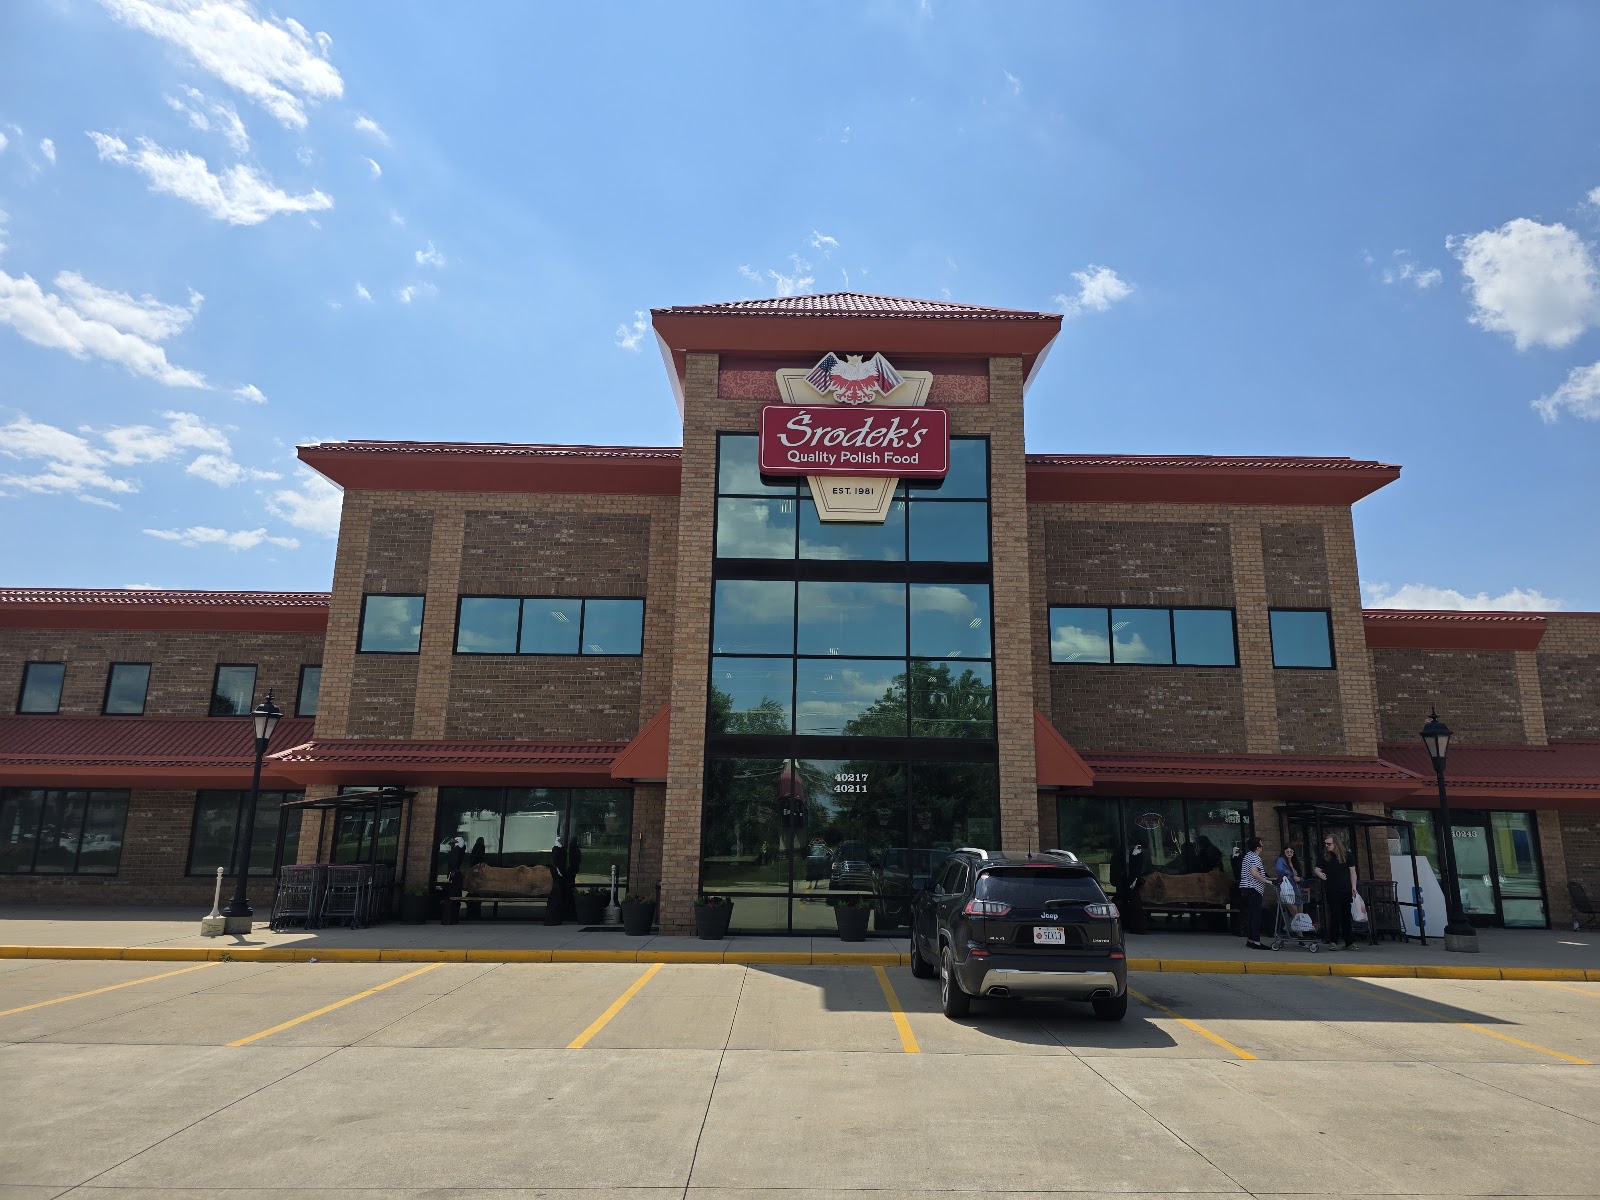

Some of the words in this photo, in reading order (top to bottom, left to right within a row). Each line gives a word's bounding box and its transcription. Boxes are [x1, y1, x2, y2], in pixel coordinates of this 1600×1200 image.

[777, 411, 928, 449] Środek's
[787, 450, 836, 466] Quality
[840, 451, 880, 464] Polish
[884, 452, 919, 465] Food
[832, 487, 851, 495] EST.
[855, 487, 874, 495] 1981
[834, 773, 869, 782] 40217
[834, 784, 868, 793] 40211
[1134, 816, 1166, 826] OPEN
[1040, 911, 1059, 920] Jeep
